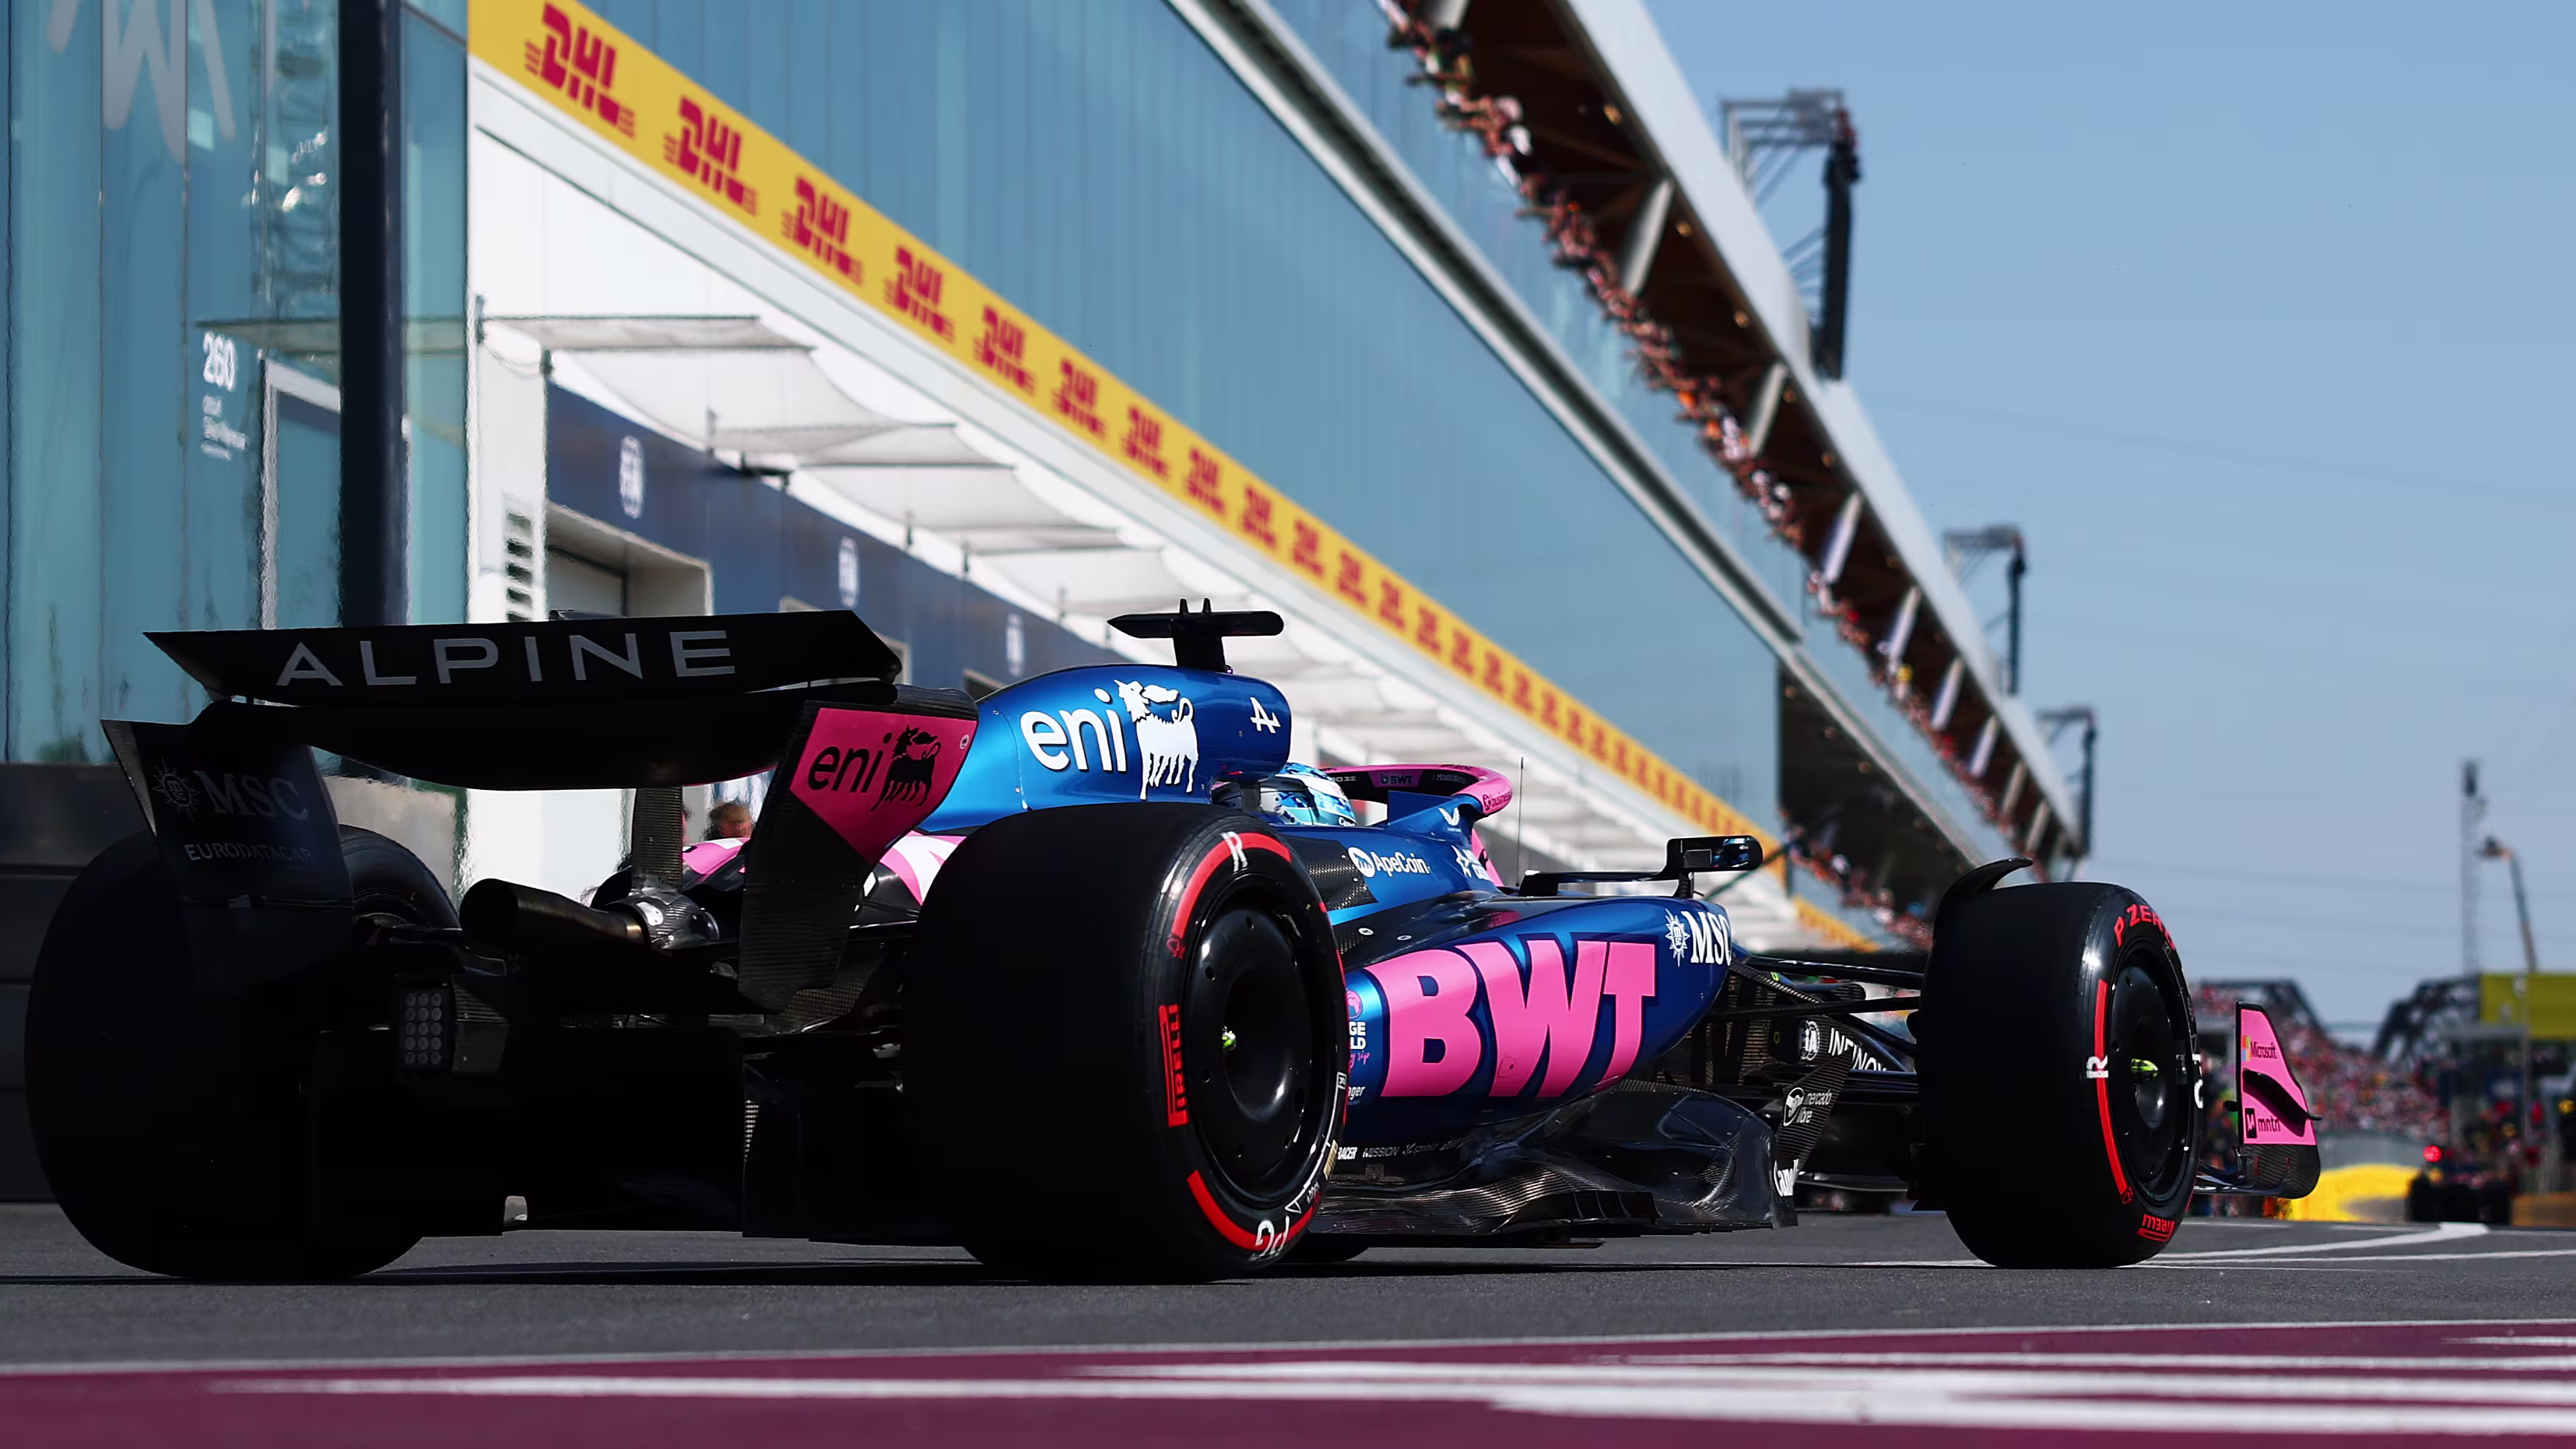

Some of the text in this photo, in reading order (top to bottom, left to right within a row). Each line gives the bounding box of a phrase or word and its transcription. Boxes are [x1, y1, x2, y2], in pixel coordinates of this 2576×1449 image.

[533, 2, 631, 134] DHL
[671, 95, 753, 209] DHL
[792, 177, 859, 280] DHL
[892, 247, 951, 337] DHL
[978, 309, 1031, 388] DHL
[275, 630, 735, 687] ALPINE
[807, 732, 893, 793] eni
[1020, 687, 1127, 773] eni
[192, 769, 310, 821] MSC
[1373, 851, 1430, 877] ApeCoin
[1365, 939, 1656, 1098] BWT
[2249, 1041, 2277, 1060] Microsoft
